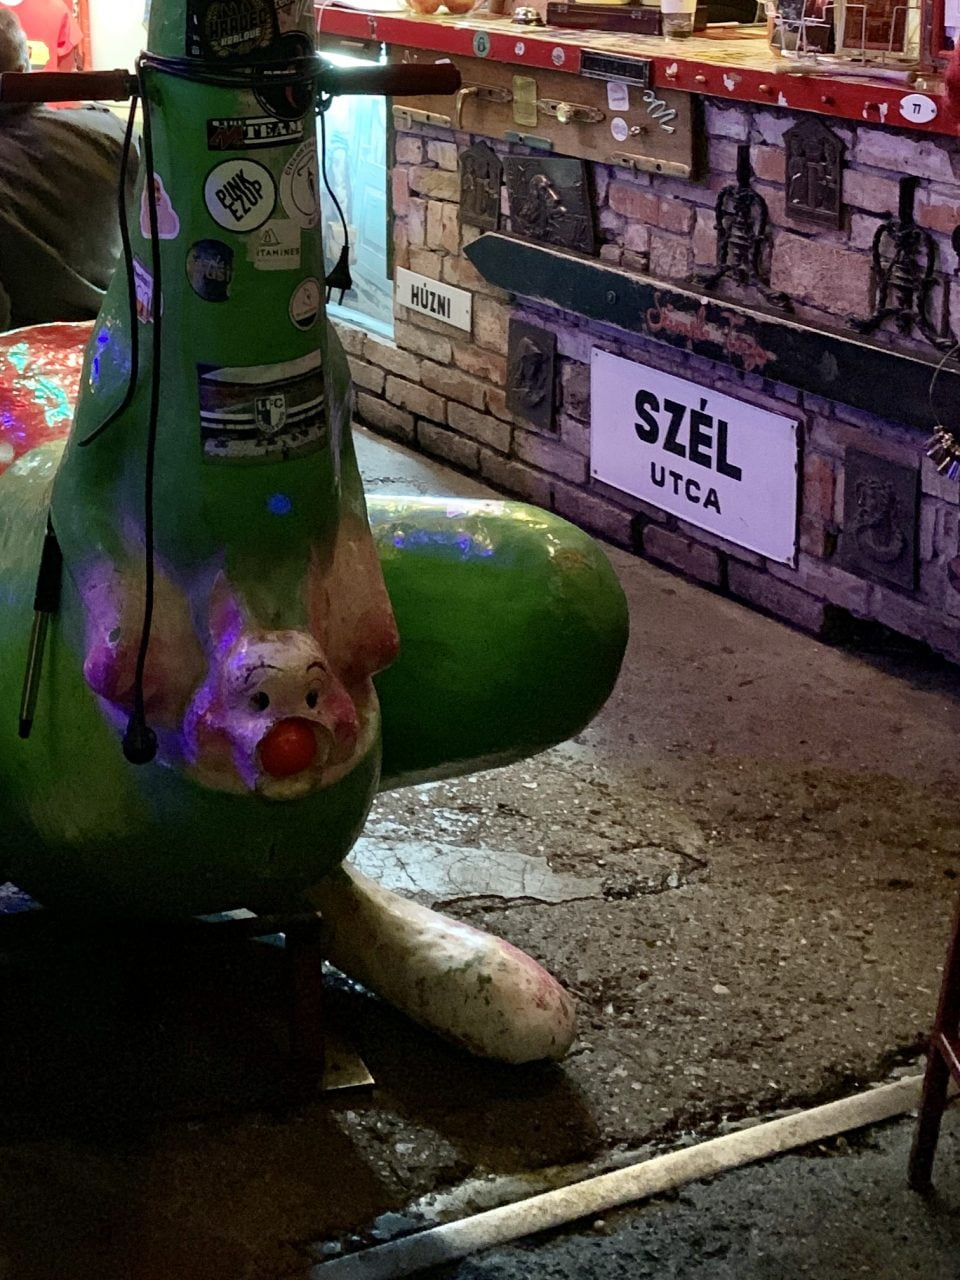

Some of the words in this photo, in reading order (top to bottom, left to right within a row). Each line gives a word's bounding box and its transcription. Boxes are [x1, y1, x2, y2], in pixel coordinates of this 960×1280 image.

[215, 168, 250, 209] PINK
[411, 282, 451, 319] HÚZNI
[634, 389, 742, 482] SZÉL
[650, 461, 722, 514] UTCA
